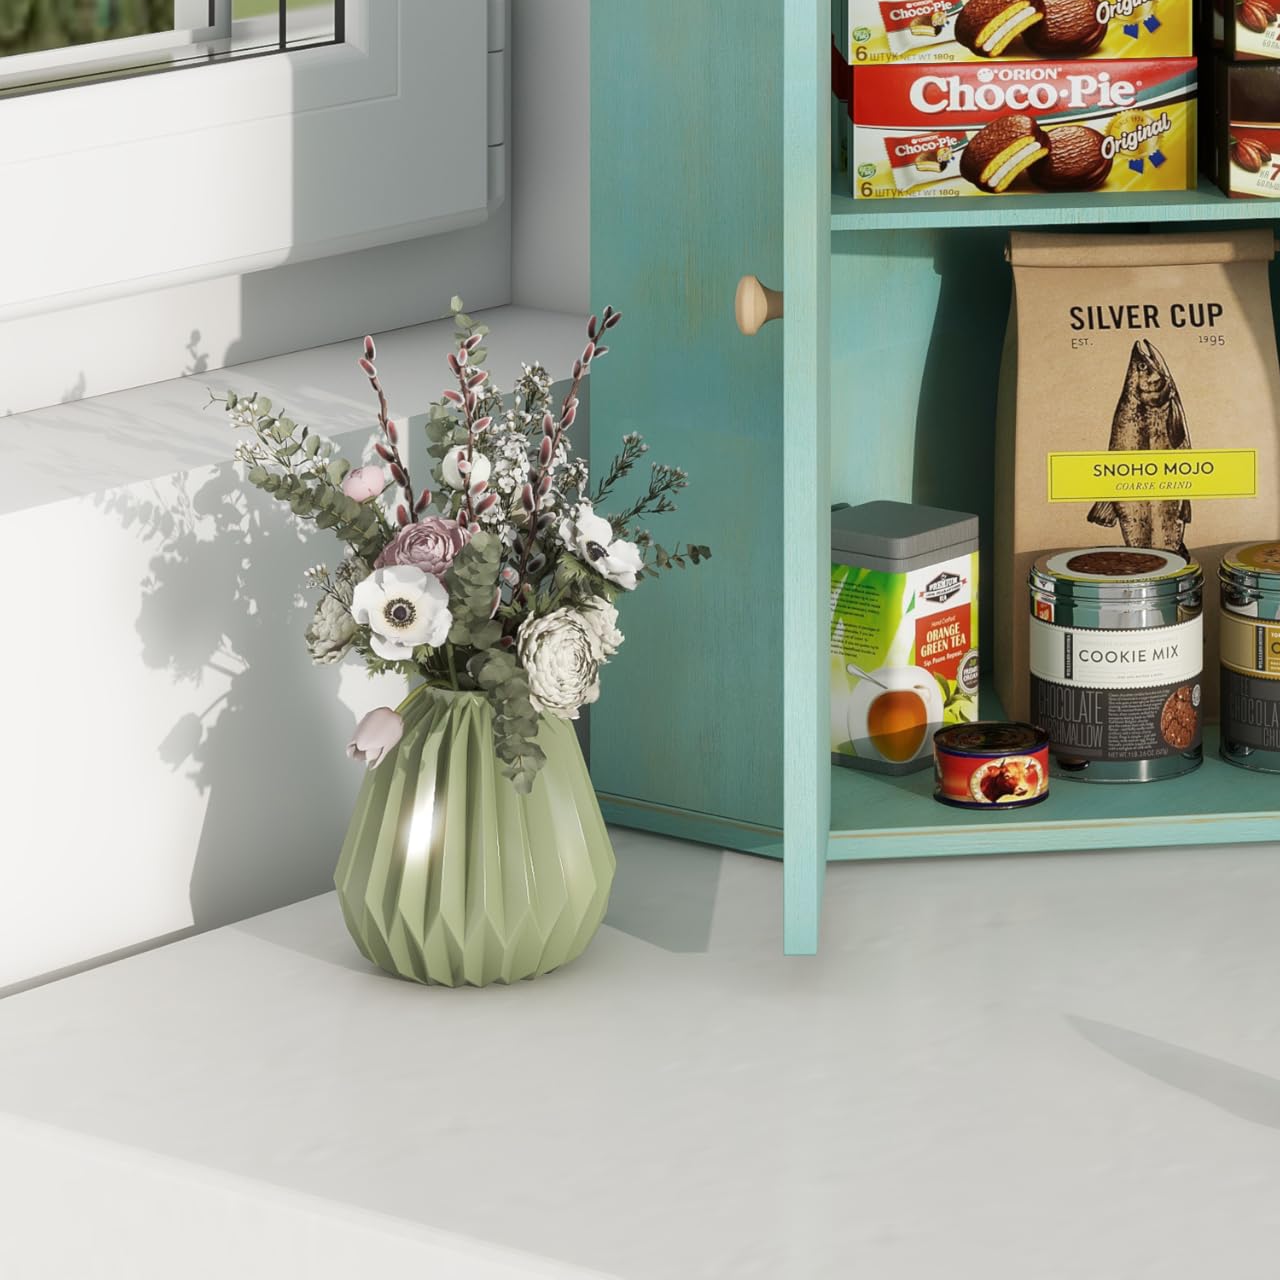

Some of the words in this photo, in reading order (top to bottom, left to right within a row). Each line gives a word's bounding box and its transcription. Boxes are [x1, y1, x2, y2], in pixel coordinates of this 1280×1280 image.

[856, 46, 868, 61] 6
[998, 68, 1059, 81] ORION
[1101, 111, 1171, 160] Original
[861, 182, 873, 197] 6
[1069, 304, 1160, 331] SILVER
[1170, 303, 1224, 328] CUP
[1071, 338, 1094, 350] EST.
[1198, 335, 1226, 347] 1995
[1093, 462, 1158, 478] SNOHO
[1164, 461, 1214, 476] MOJO
[1115, 481, 1156, 491] COARSE
[1159, 480, 1193, 490] GRIND
[926, 622, 960, 643] ORANGE
[921, 639, 949, 658] GREEN
[951, 633, 967, 649] TEA
[1079, 649, 1146, 663] COOKIE
[1152, 644, 1179, 661] MIX
